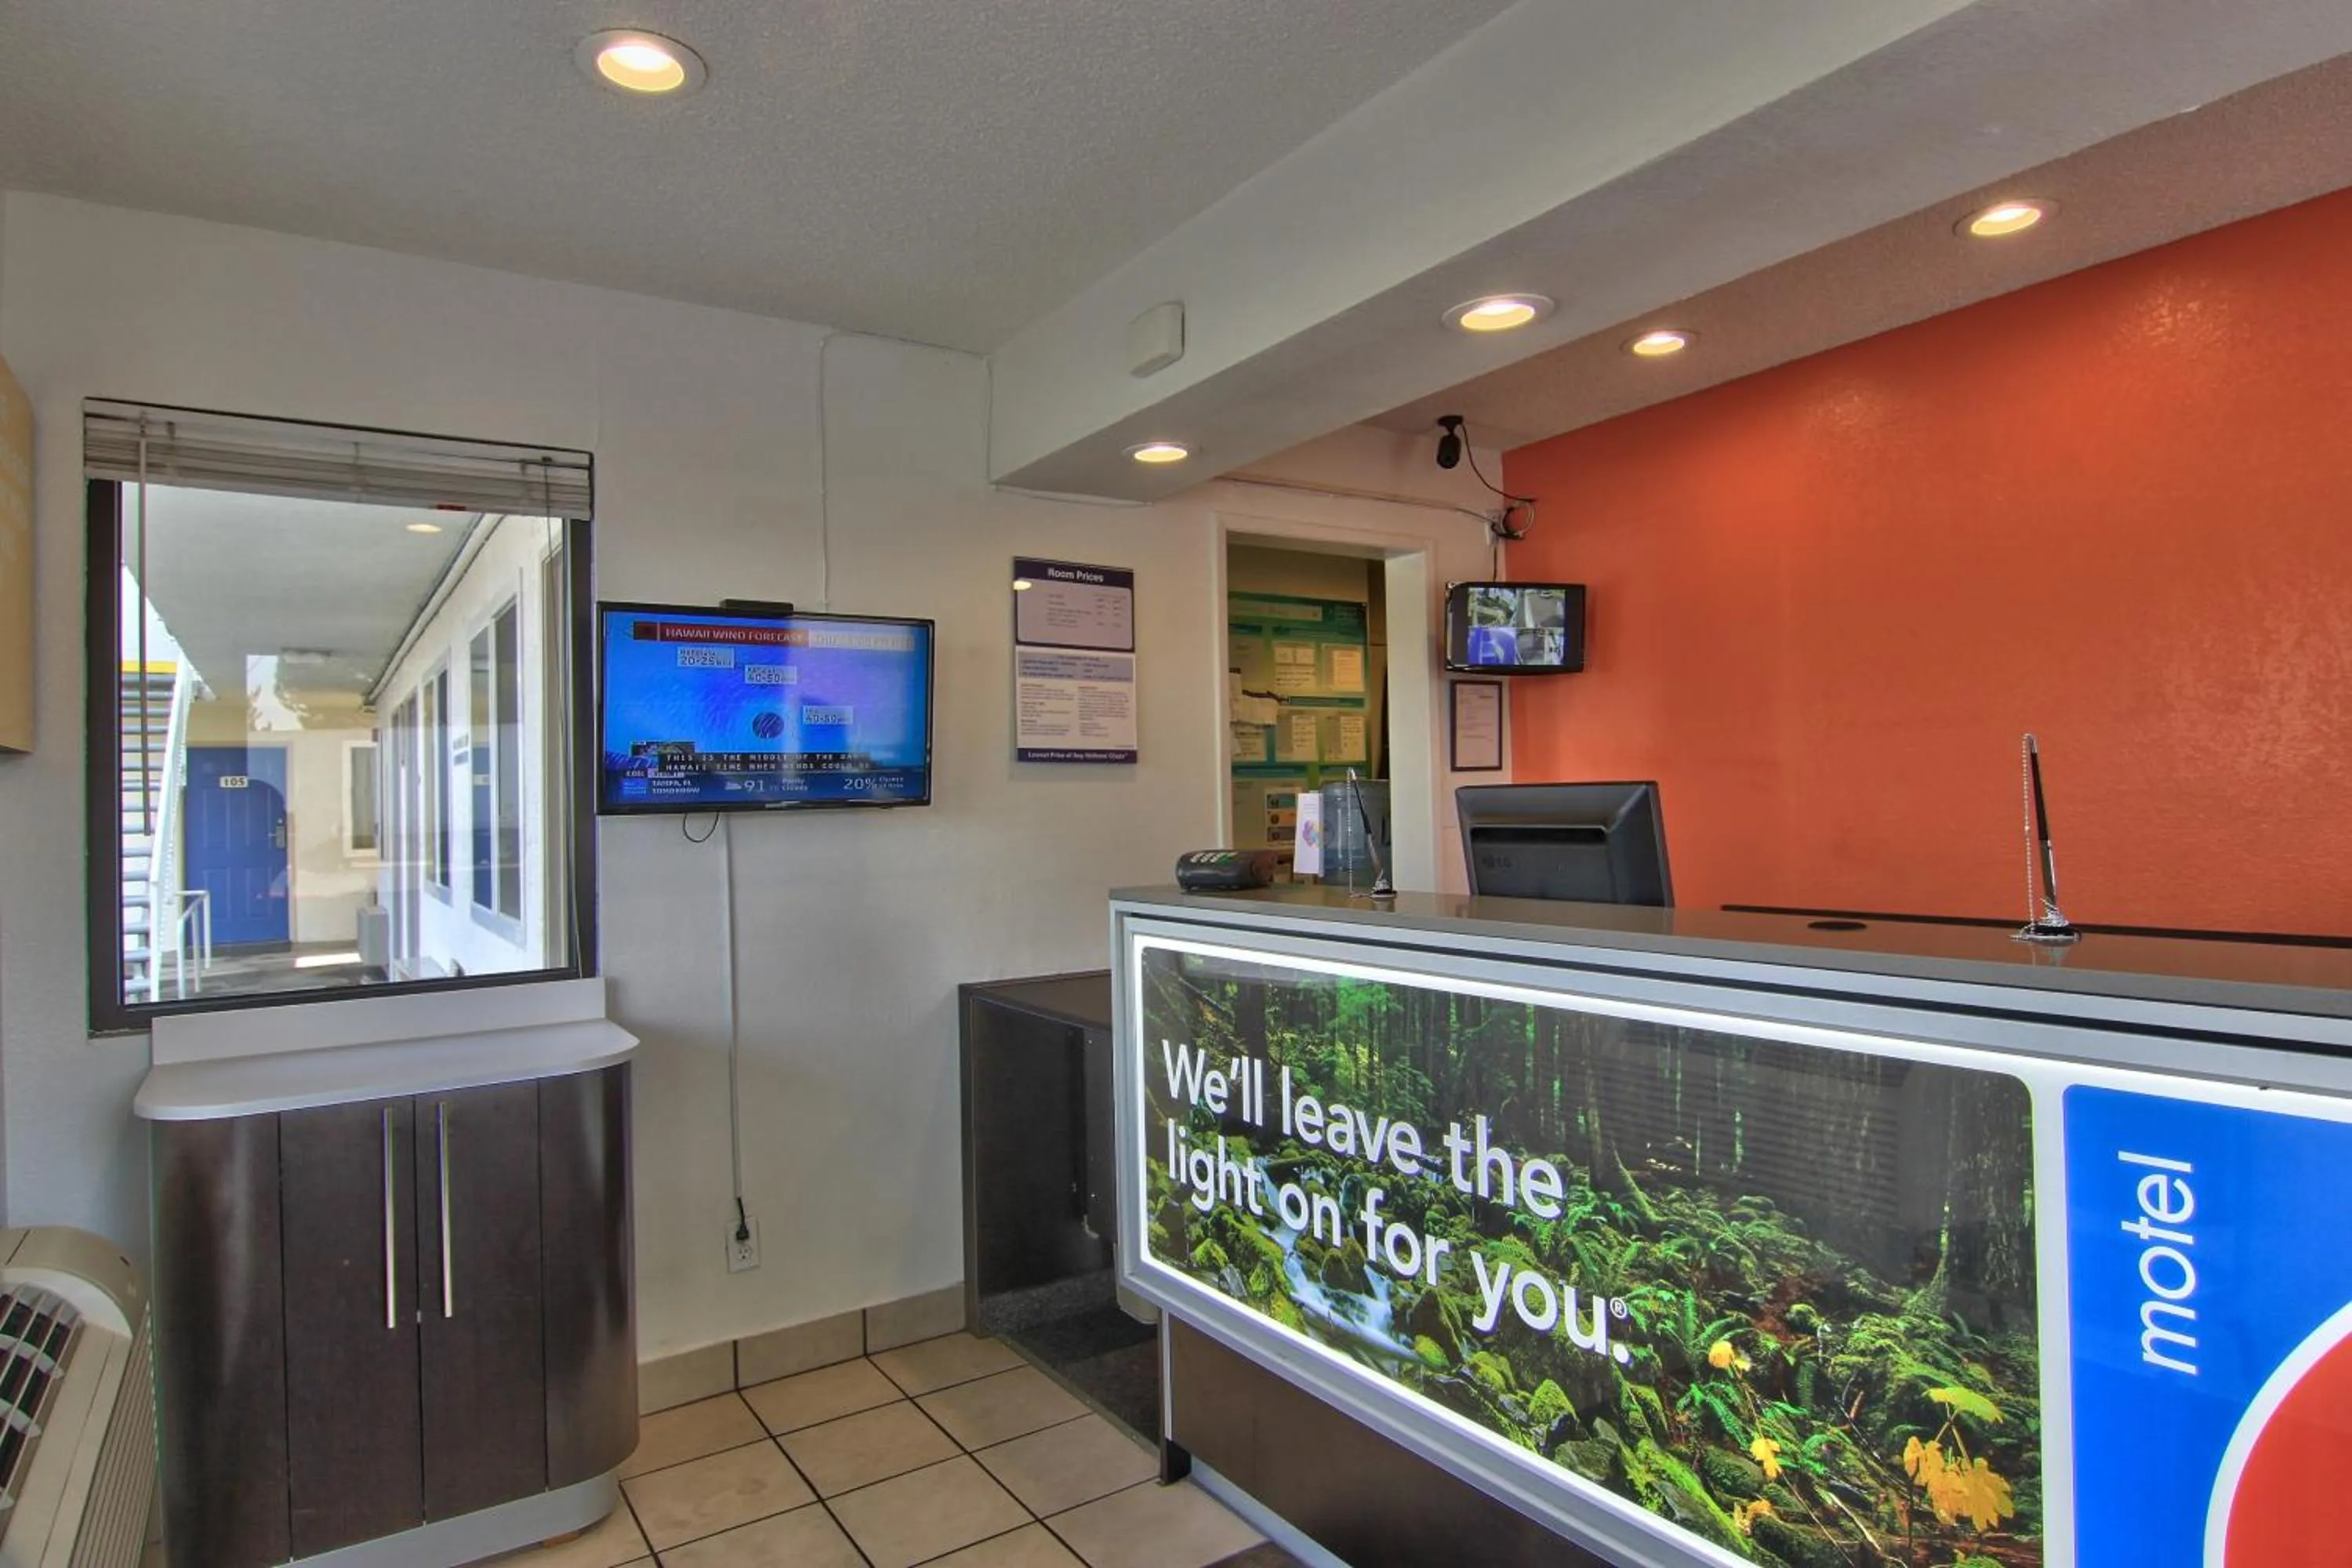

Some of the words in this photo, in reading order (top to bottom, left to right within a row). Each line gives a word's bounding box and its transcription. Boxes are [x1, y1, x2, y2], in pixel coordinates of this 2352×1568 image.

[1047, 568, 1075, 579] Room
[1076, 570, 1105, 583] Prices
[666, 626, 710, 639] HAWAII
[713, 629, 746, 641] WIND
[223, 777, 245, 786] 105
[744, 780, 764, 793] 91
[843, 777, 877, 790] 20%
[1163, 1039, 1264, 1127] We'll
[1282, 1065, 1425, 1175] leave
[1443, 1114, 1563, 1219] the
[1167, 1117, 1264, 1216] light
[1279, 1182, 1341, 1247] on
[1360, 1187, 1450, 1287] for
[2118, 1149, 2197, 1375] motel
